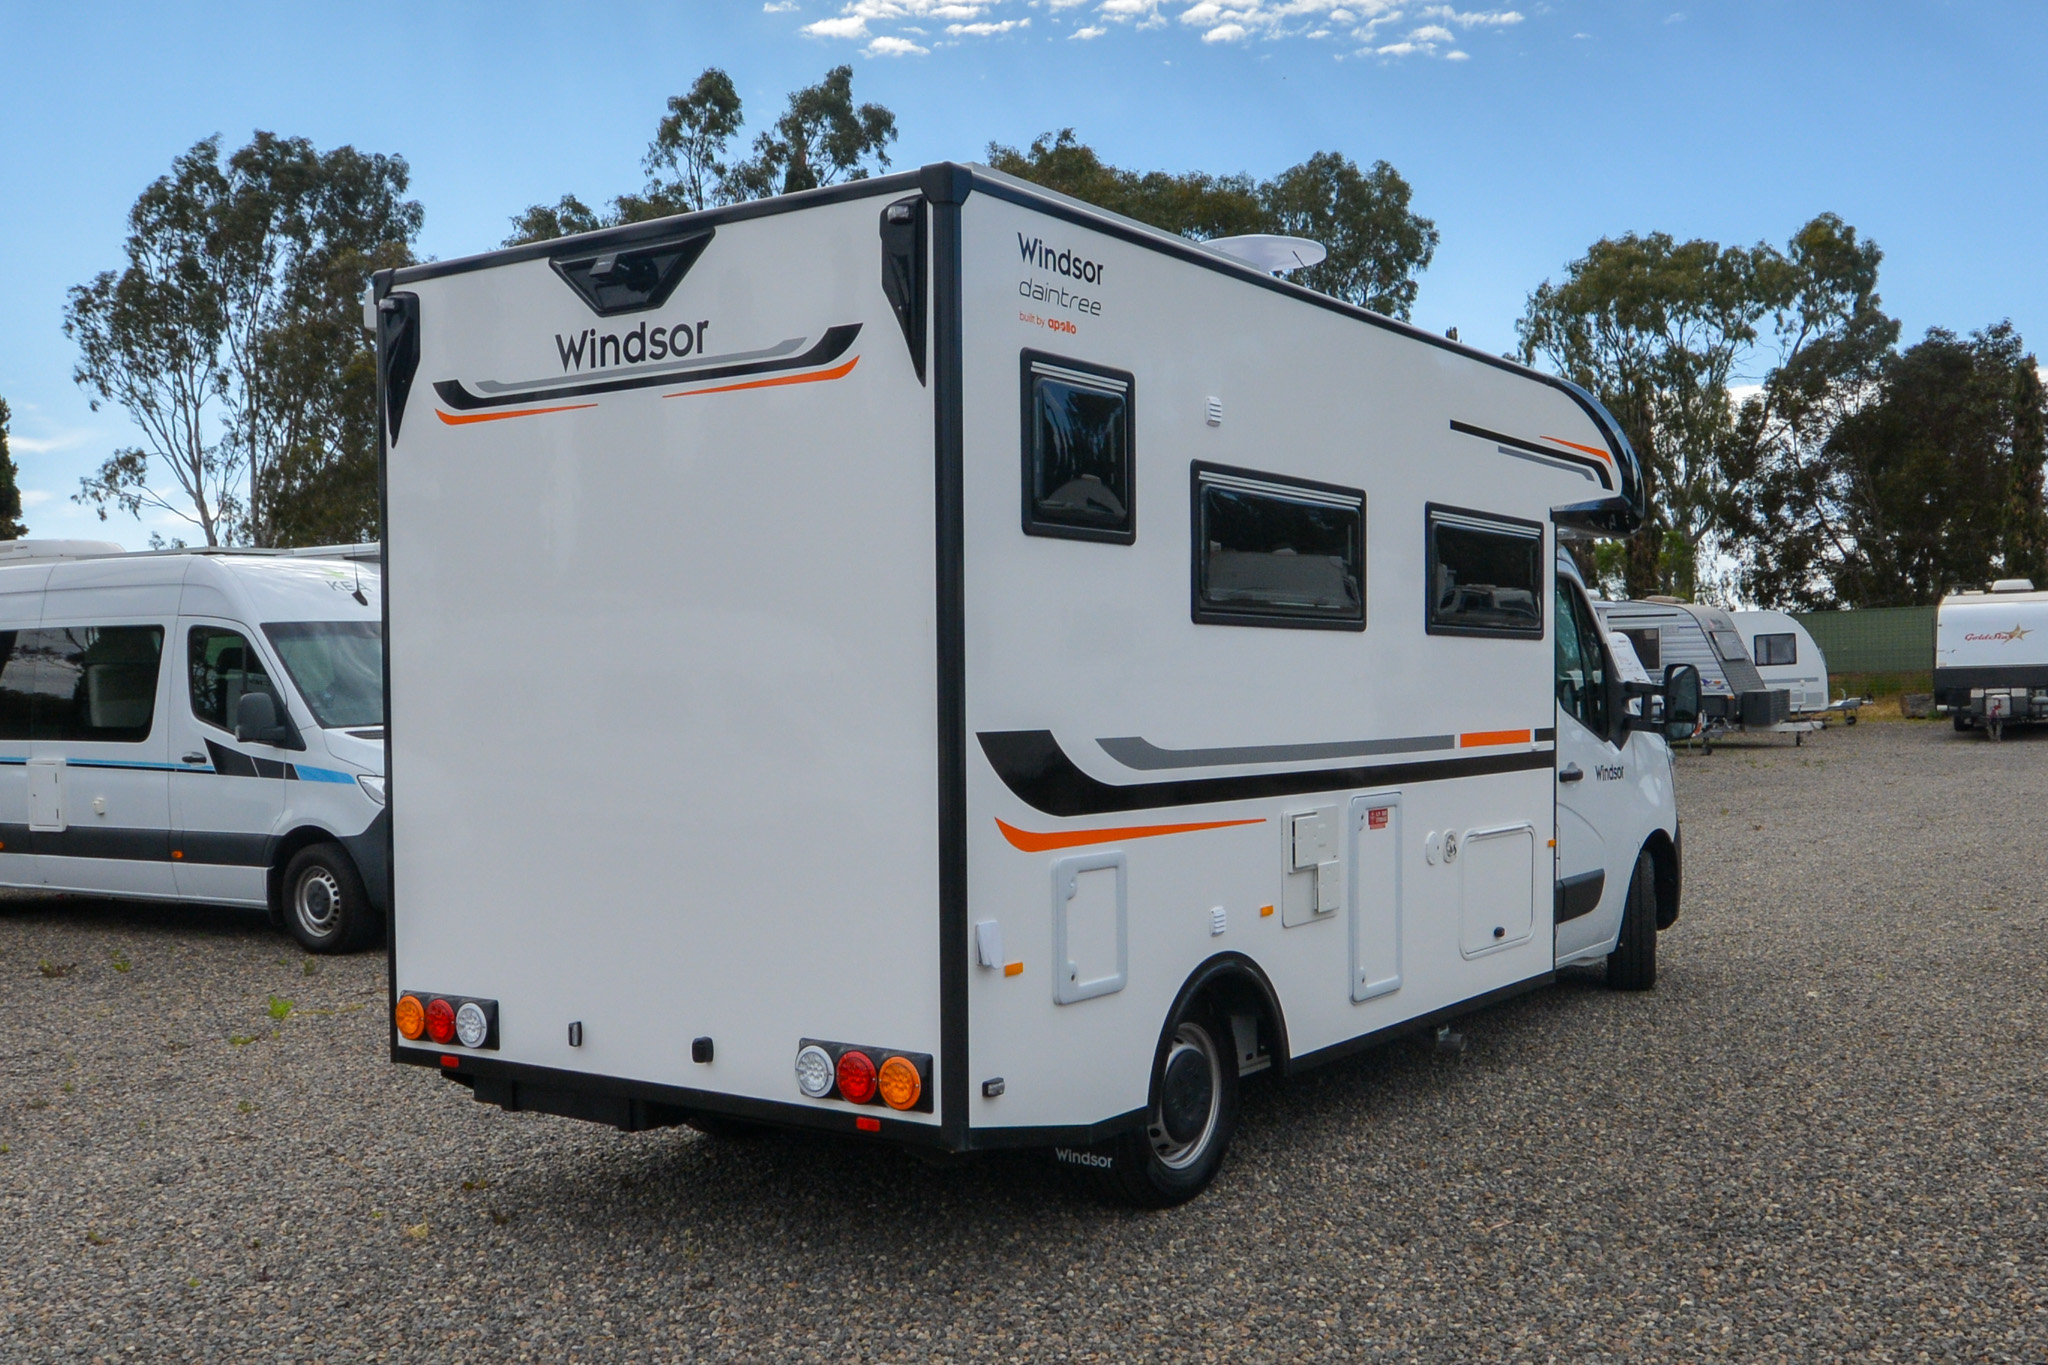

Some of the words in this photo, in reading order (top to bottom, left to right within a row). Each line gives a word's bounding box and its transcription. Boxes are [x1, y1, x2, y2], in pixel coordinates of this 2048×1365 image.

[1017, 231, 1104, 285] Windsor
[1018, 277, 1102, 316] daintree
[1019, 311, 1035, 324] built
[1036, 315, 1046, 328] by
[1048, 318, 1077, 334] apollo
[555, 320, 709, 373] Windsor
[325, 580, 373, 592] KEA
[1594, 764, 1624, 781] Windsor
[1055, 1147, 1113, 1168] Windsor
